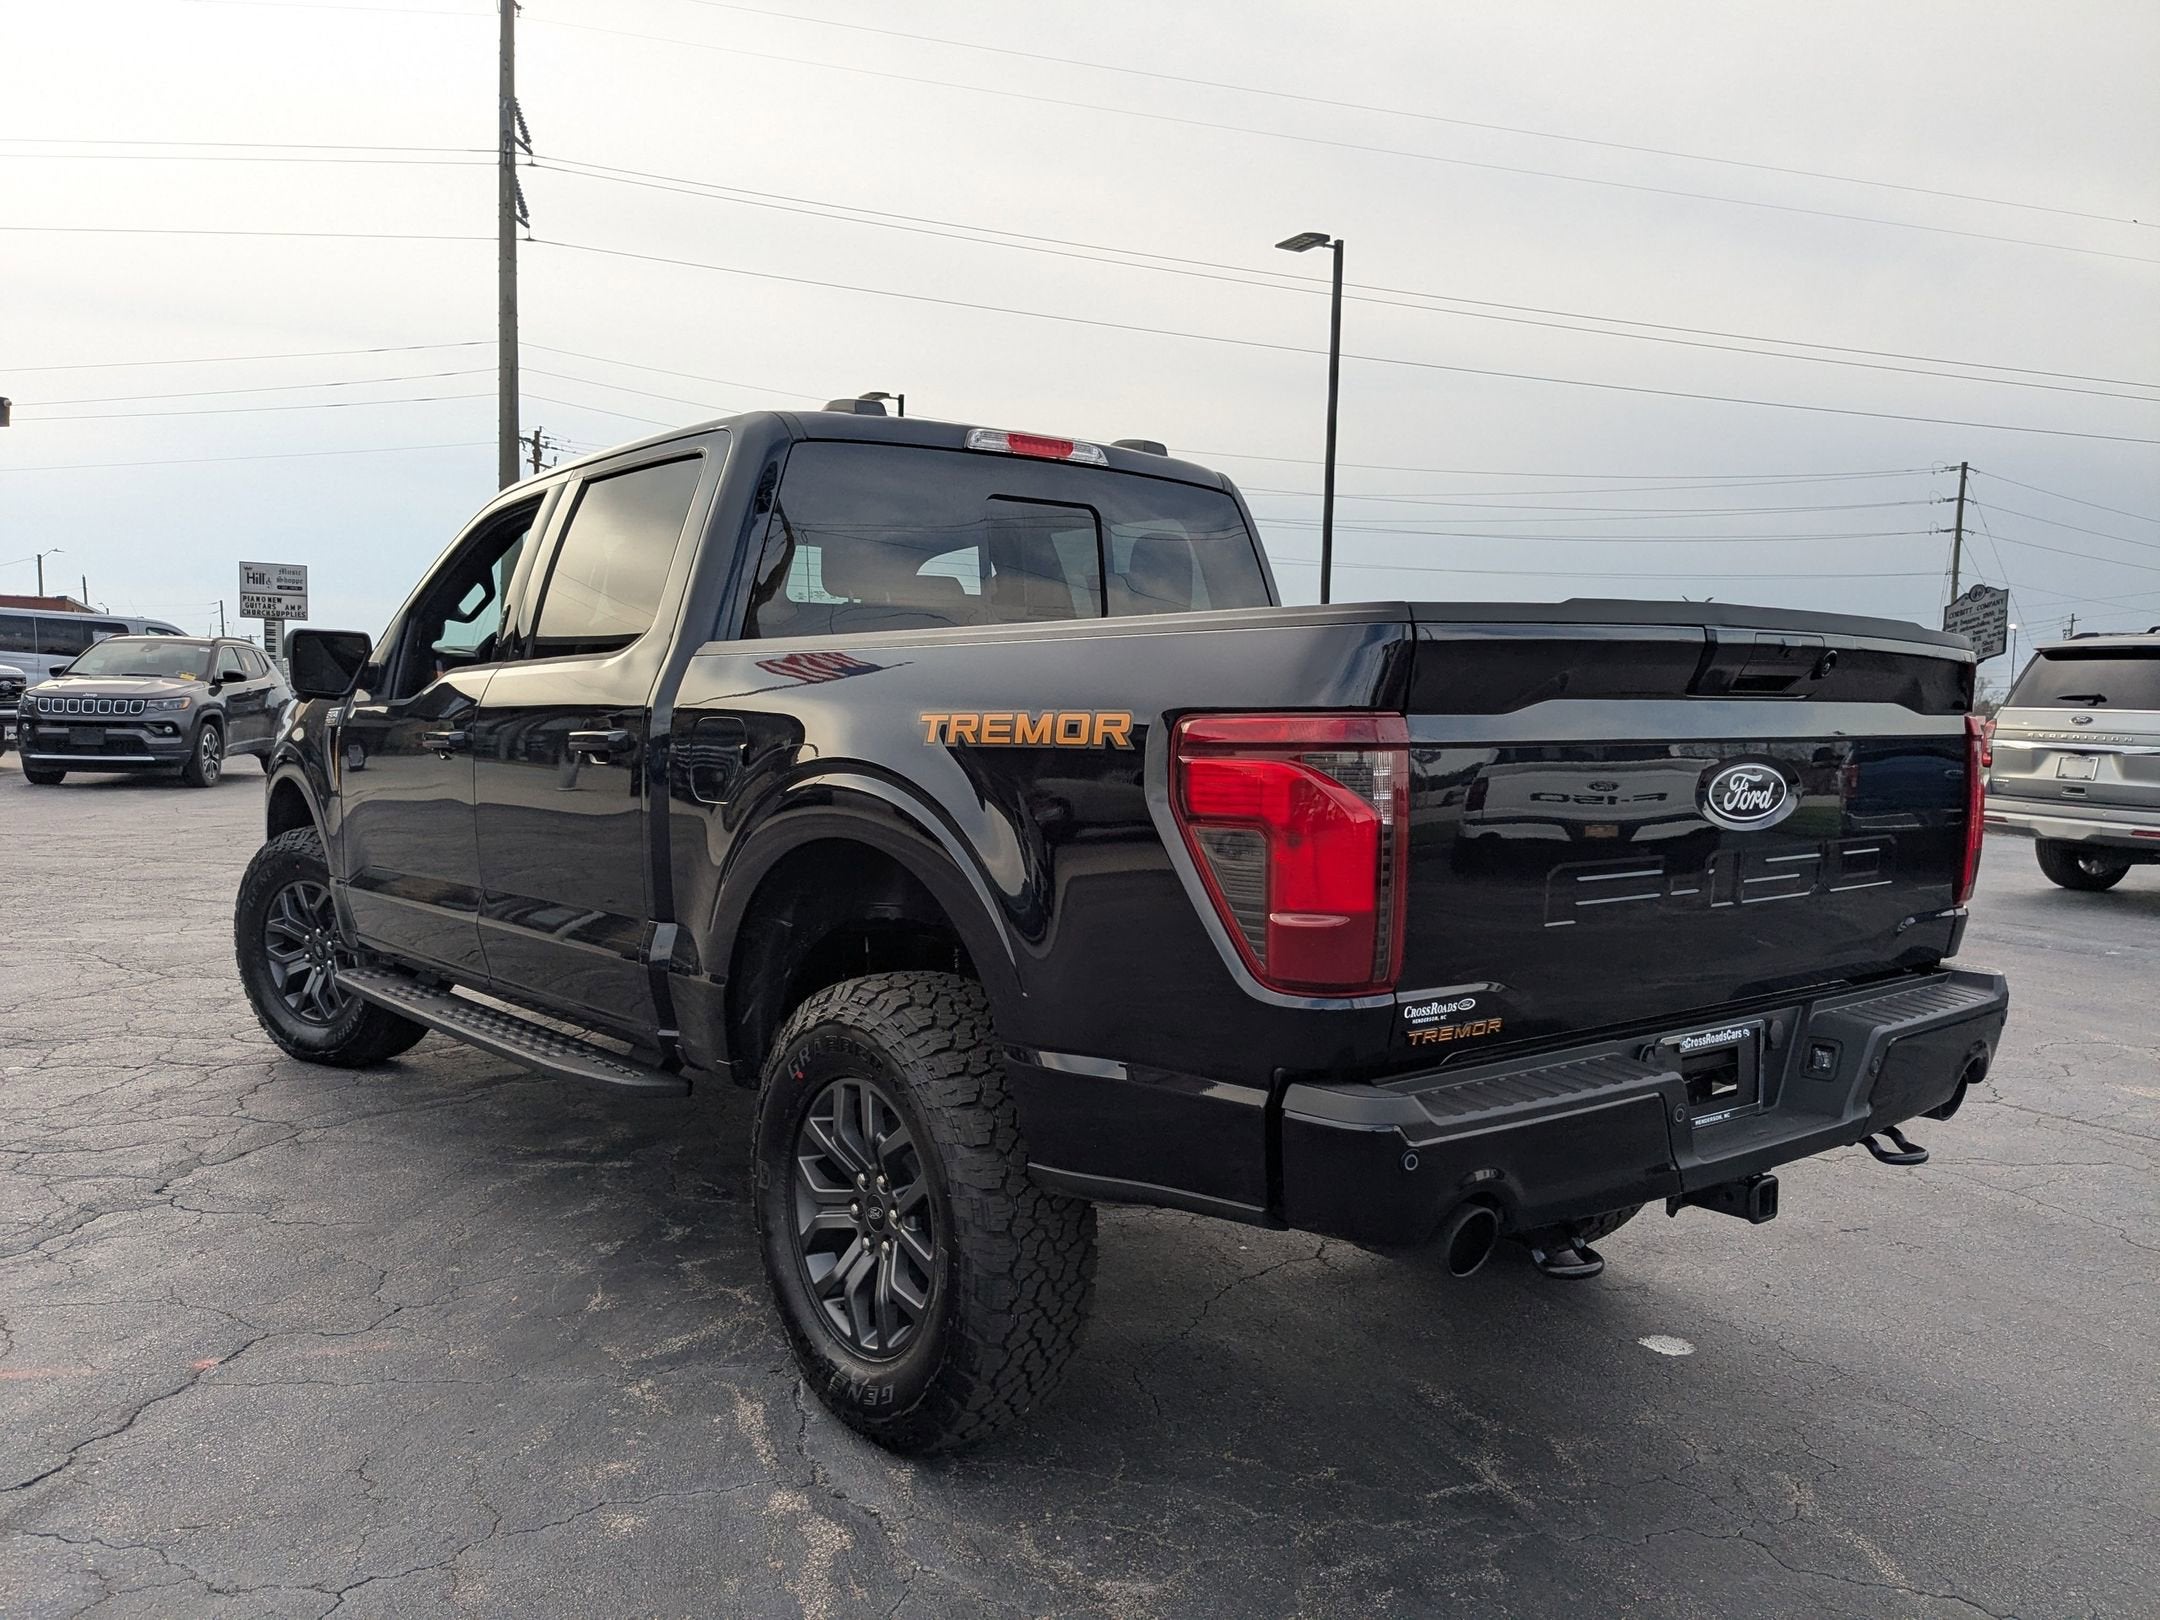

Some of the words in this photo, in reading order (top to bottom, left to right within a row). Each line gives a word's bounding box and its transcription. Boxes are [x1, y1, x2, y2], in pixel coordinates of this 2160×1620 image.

[278, 568, 302, 576] Music
[276, 576, 304, 585] Shoppe
[268, 596, 283, 604] NEW
[1976, 598, 2004, 611] COMPANY
[245, 602, 277, 610] GUITARS
[271, 610, 306, 618] SUPPLIES
[919, 710, 1134, 749] TREMOR
[2026, 732, 2134, 744] EXPEDITION
[1723, 773, 1774, 811] Ford
[1411, 1016, 1439, 1024] HENDERSON,
[1407, 1017, 1503, 1046] TREMOR
